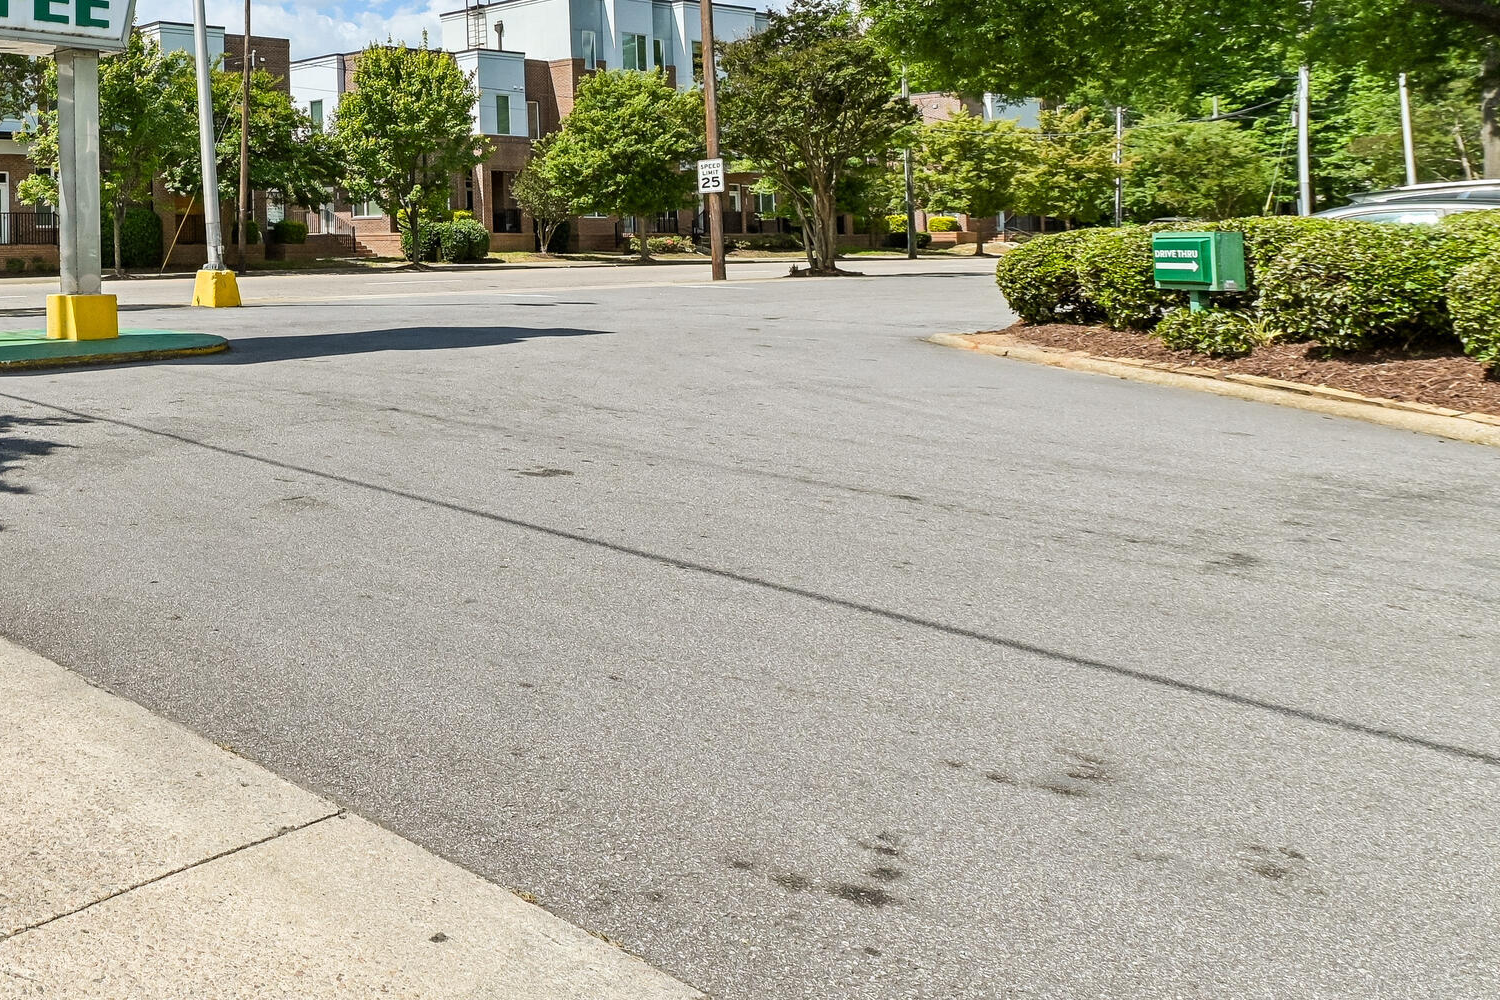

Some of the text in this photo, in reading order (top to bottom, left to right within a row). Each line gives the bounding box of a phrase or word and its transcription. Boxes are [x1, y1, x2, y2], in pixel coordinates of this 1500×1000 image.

[702, 176, 720, 188] 25
[1154, 250, 1198, 258] DRIVE THRU
